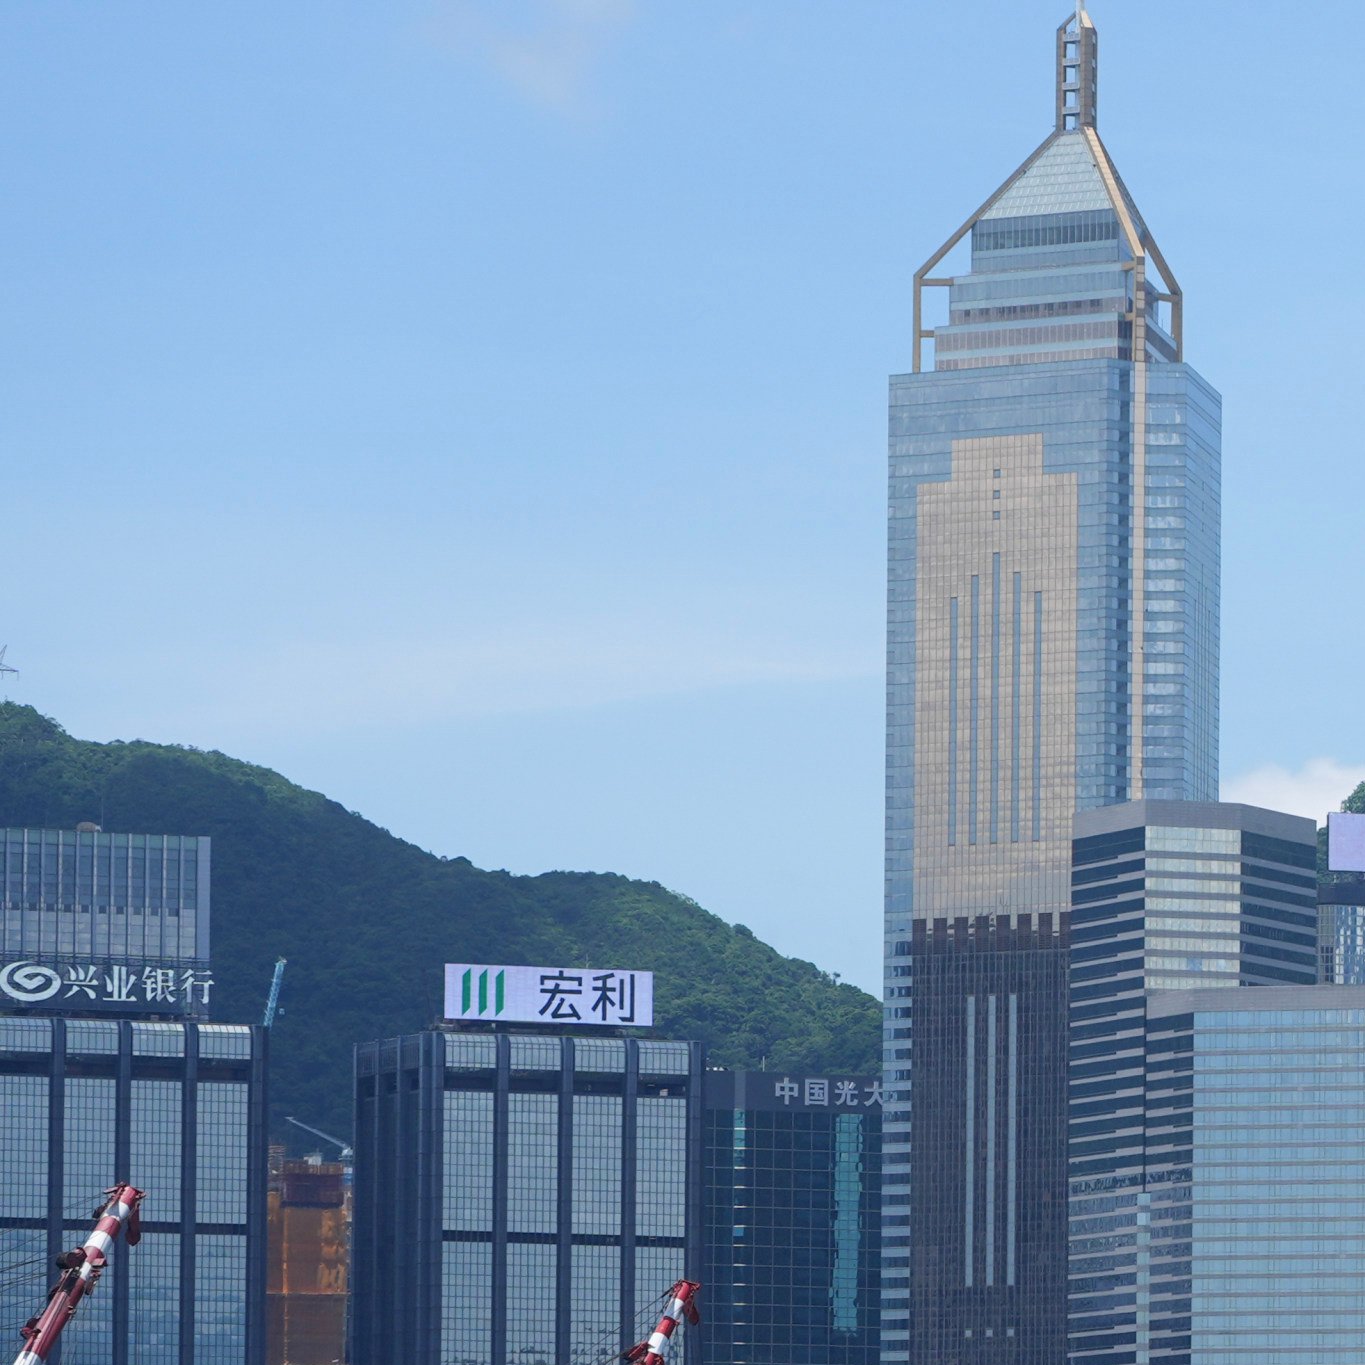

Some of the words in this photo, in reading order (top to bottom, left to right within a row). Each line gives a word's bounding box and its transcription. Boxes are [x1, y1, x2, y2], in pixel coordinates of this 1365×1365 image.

[63, 965, 215, 1004] 兴业银行
[538, 970, 635, 1023] 宏利
